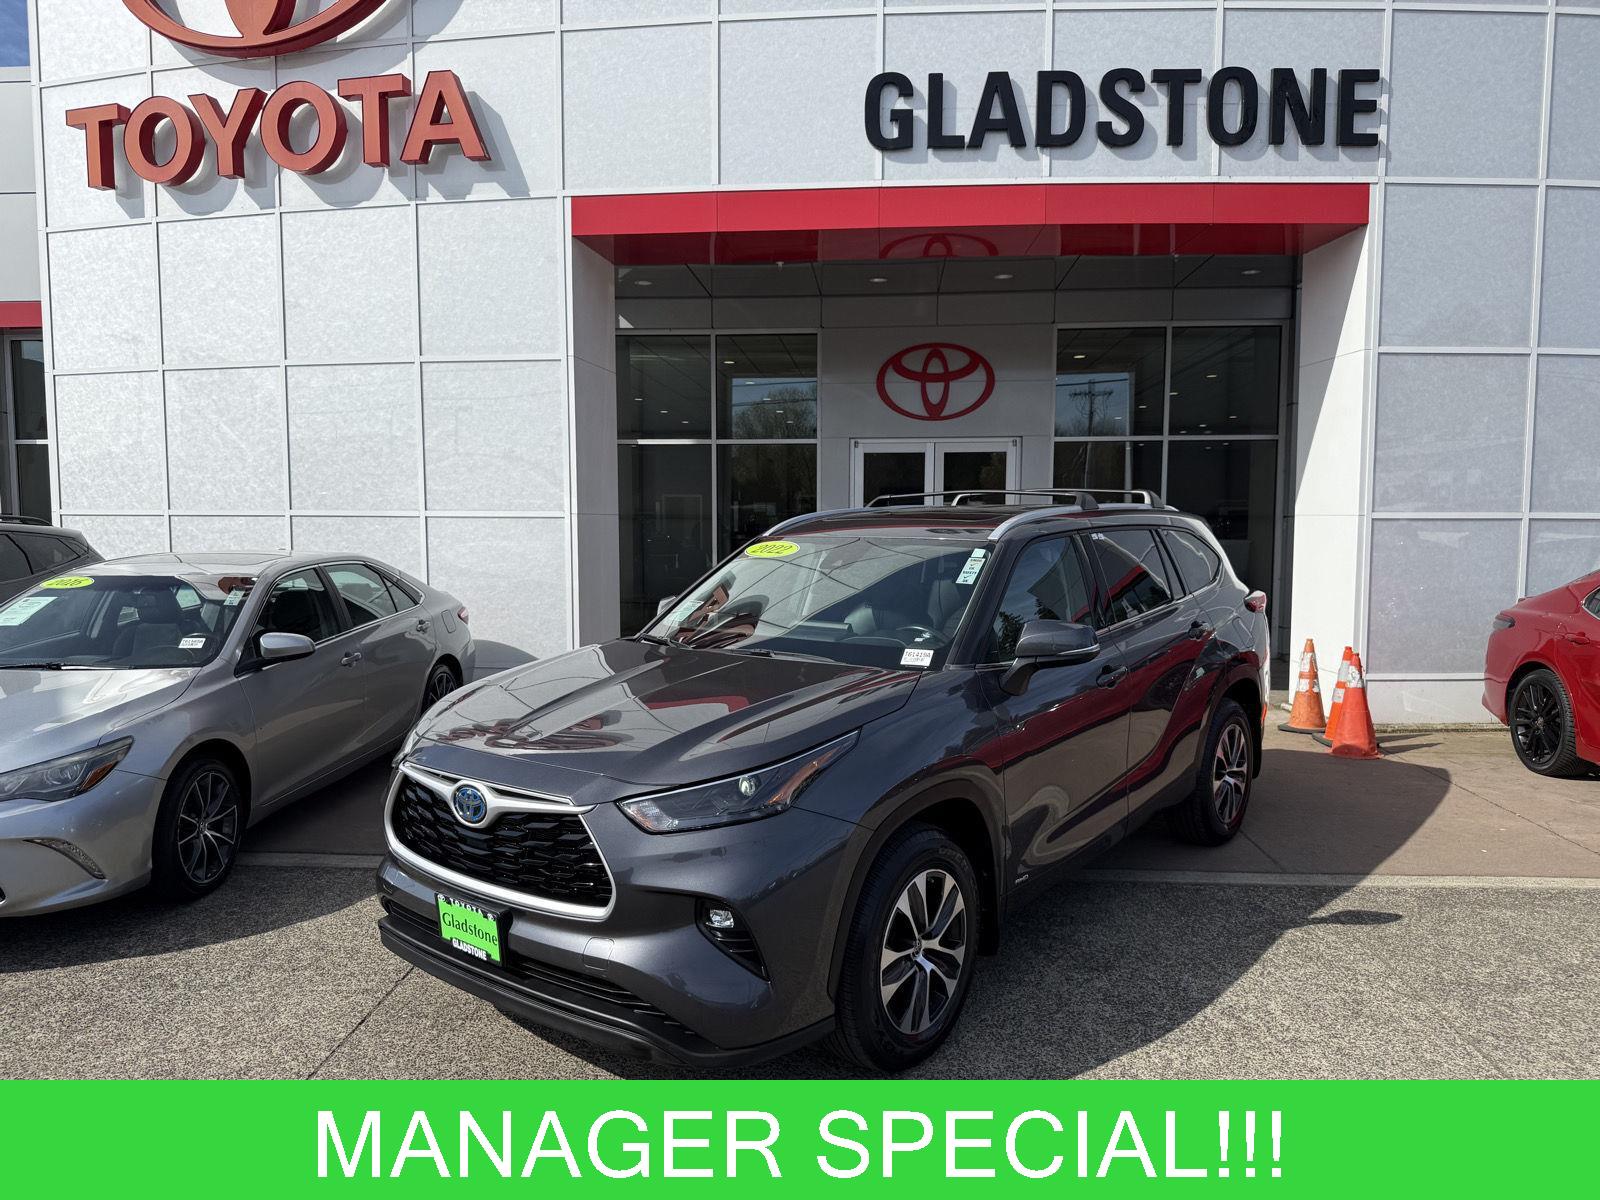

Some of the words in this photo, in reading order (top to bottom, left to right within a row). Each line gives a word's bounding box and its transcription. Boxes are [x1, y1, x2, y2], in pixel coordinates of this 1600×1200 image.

[864, 66, 1380, 152] GLADSTONE
[66, 70, 491, 190] TOYOTA
[449, 898, 483, 915] TOYOTA
[442, 912, 498, 946] Gladstone
[452, 938, 487, 961] GLADSTONE
